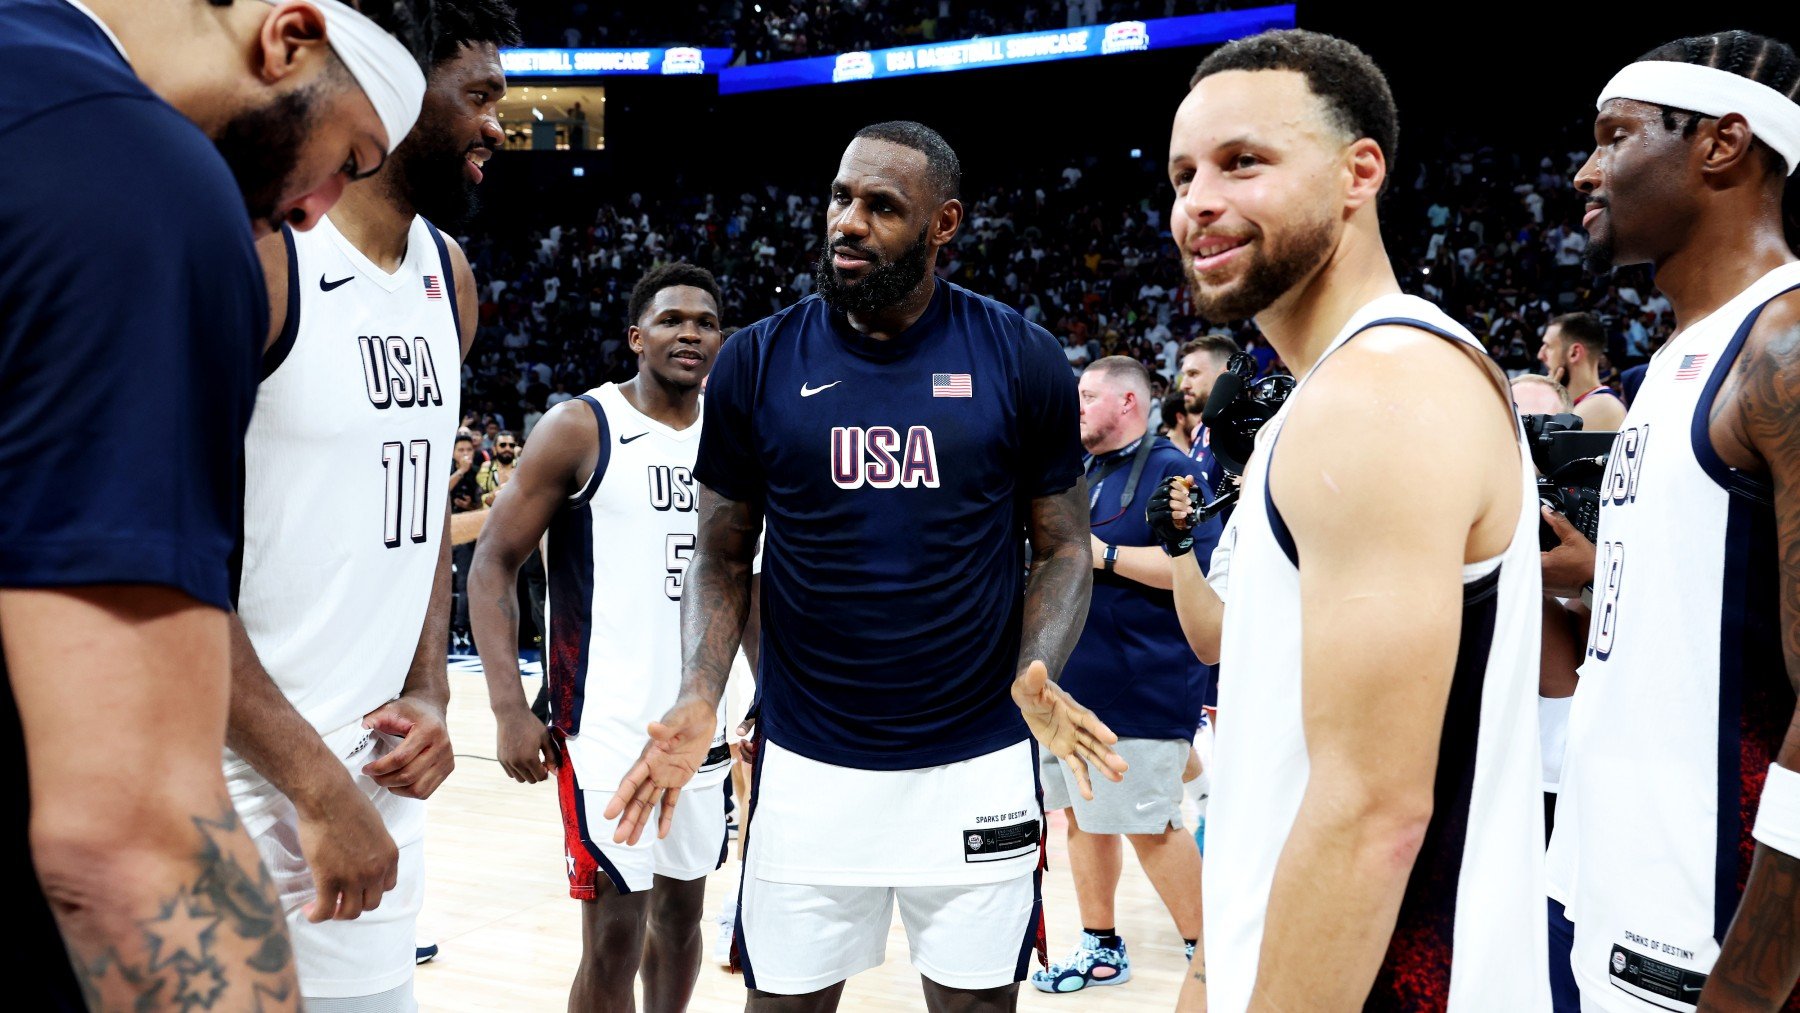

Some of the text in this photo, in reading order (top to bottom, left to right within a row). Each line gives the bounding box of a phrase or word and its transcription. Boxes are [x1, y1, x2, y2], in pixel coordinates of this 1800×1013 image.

[499, 52, 572, 70] ASKETBALL
[574, 52, 650, 70] SHOWCASE
[886, 50, 915, 72] USA
[917, 41, 1004, 68] BASKETBALL
[1006, 31, 1089, 58] SHOWCASE
[358, 336, 443, 409] USA
[831, 425, 940, 490] USA
[382, 439, 430, 548] 11
[648, 466, 700, 513] US
[664, 534, 696, 601] 5
[976, 810, 1028, 824] SPARKS OF DESTINY
[1625, 930, 1694, 960] SPARKS OF DESTINY
